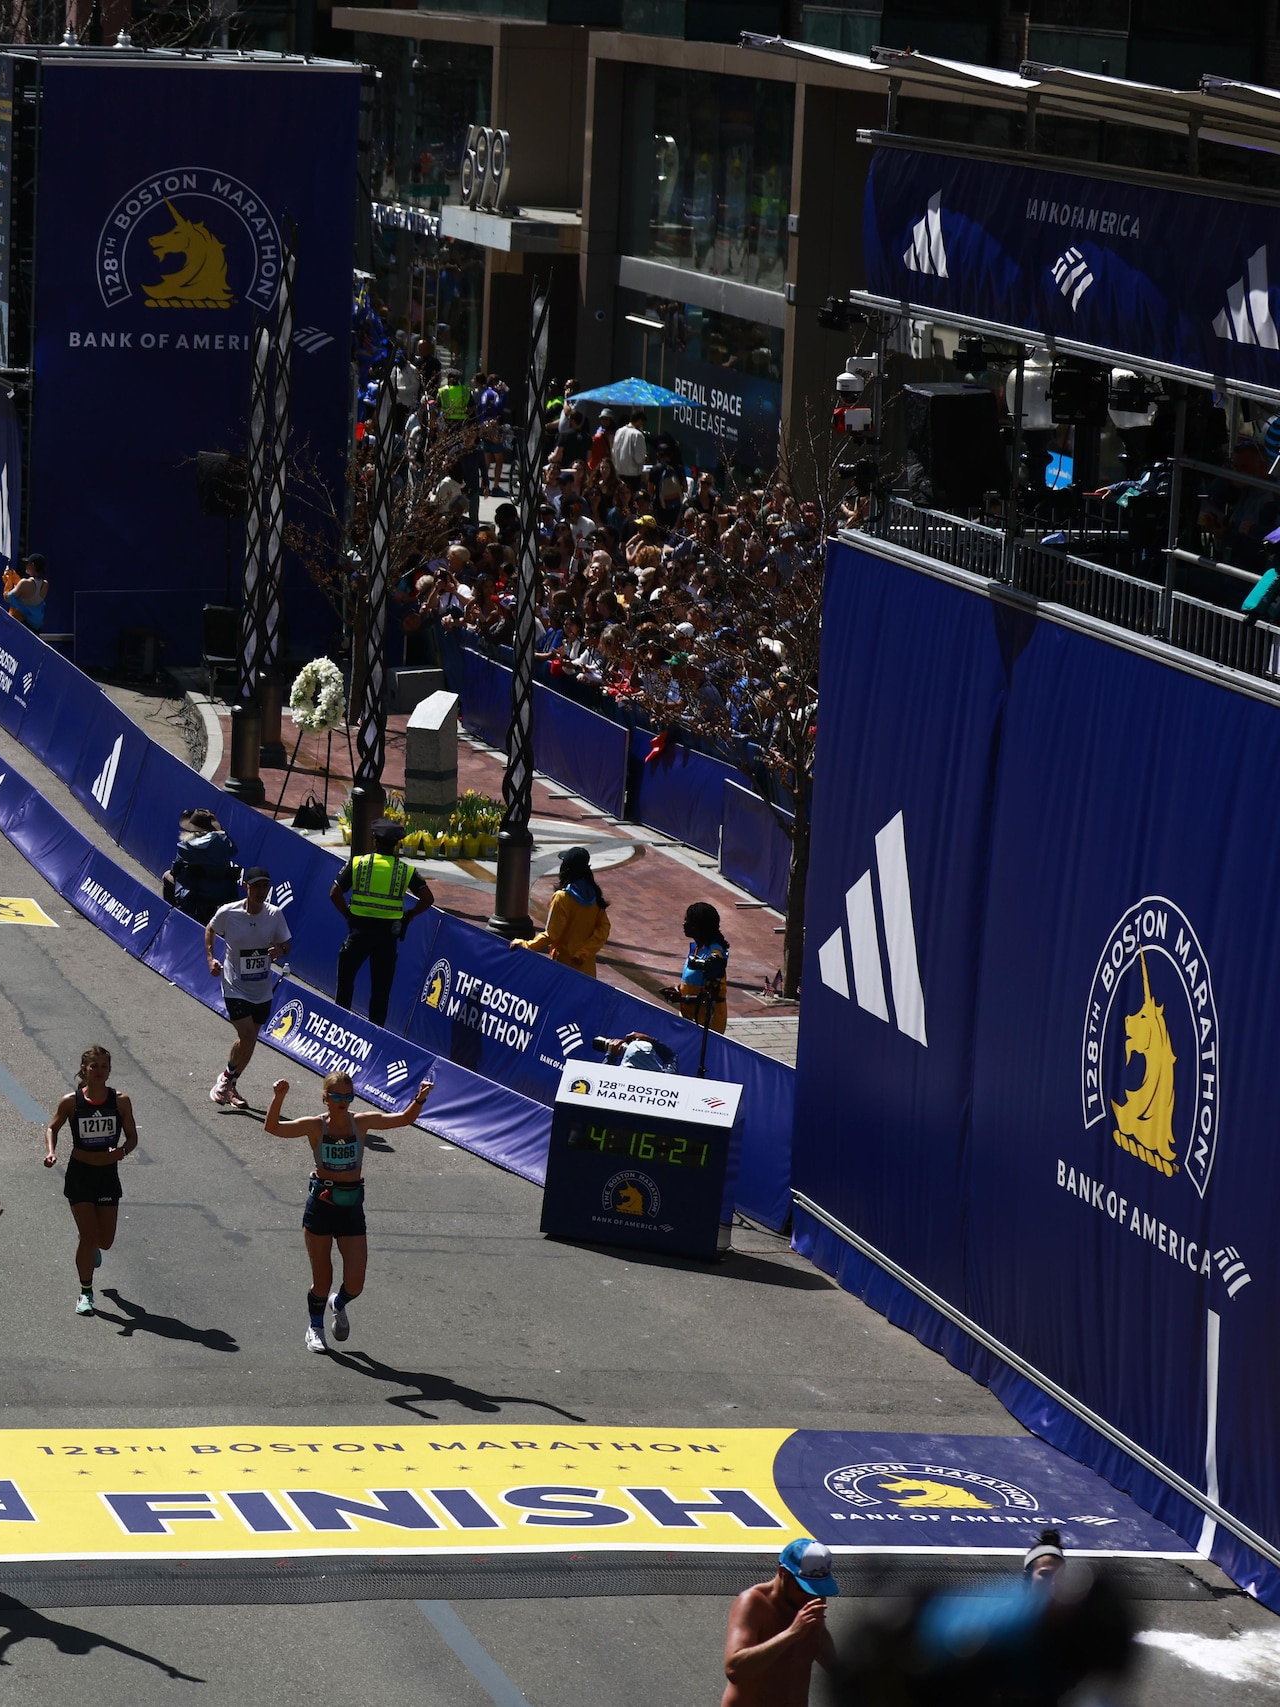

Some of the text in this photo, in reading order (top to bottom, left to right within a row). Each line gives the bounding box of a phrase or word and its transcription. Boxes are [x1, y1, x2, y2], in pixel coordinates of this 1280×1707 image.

[460, 124, 510, 212] 699
[104, 174, 277, 297] 128TH BOSTON MARATHON
[1076, 207, 1140, 239] AMERICA
[69, 332, 278, 350] BANK OF AMERIA
[675, 377, 742, 416] RETAIL SPACE
[674, 406, 692, 426] FOR
[695, 409, 726, 437] LEASE
[81, 877, 104, 901] BANK
[103, 897, 133, 927] AMERICA
[245, 957, 266, 970] 8755
[455, 970, 539, 1027] THE BOSTON
[305, 1011, 372, 1061] THE BOSTON
[446, 996, 533, 1053] MARATHON
[1087, 909, 1216, 1167] 128TH BOSTON MARATHON
[288, 1033, 362, 1078] MARATHON
[540, 1054, 554, 1067] BANK
[596, 1089, 679, 1108] MARATHON
[598, 1080, 680, 1099] 128TH BOSTON
[82, 1118, 113, 1133] 12179
[325, 1145, 355, 1160] 16366
[609, 1172, 635, 1188] BOSTON
[639, 1174, 659, 1213] MARATHON
[592, 1215, 612, 1224] BANK
[624, 1220, 658, 1231] AMERICA
[1056, 1159, 1212, 1280] BANK OF AMERICA
[37, 1438, 720, 1457] 128TH BOSTON MARATHON
[833, 1464, 907, 1483] BOSTON
[925, 1465, 1032, 1509] MARATHON
[97, 1485, 788, 1536] FINISH
[830, 1512, 1067, 1525] BANK OF AMERICA
